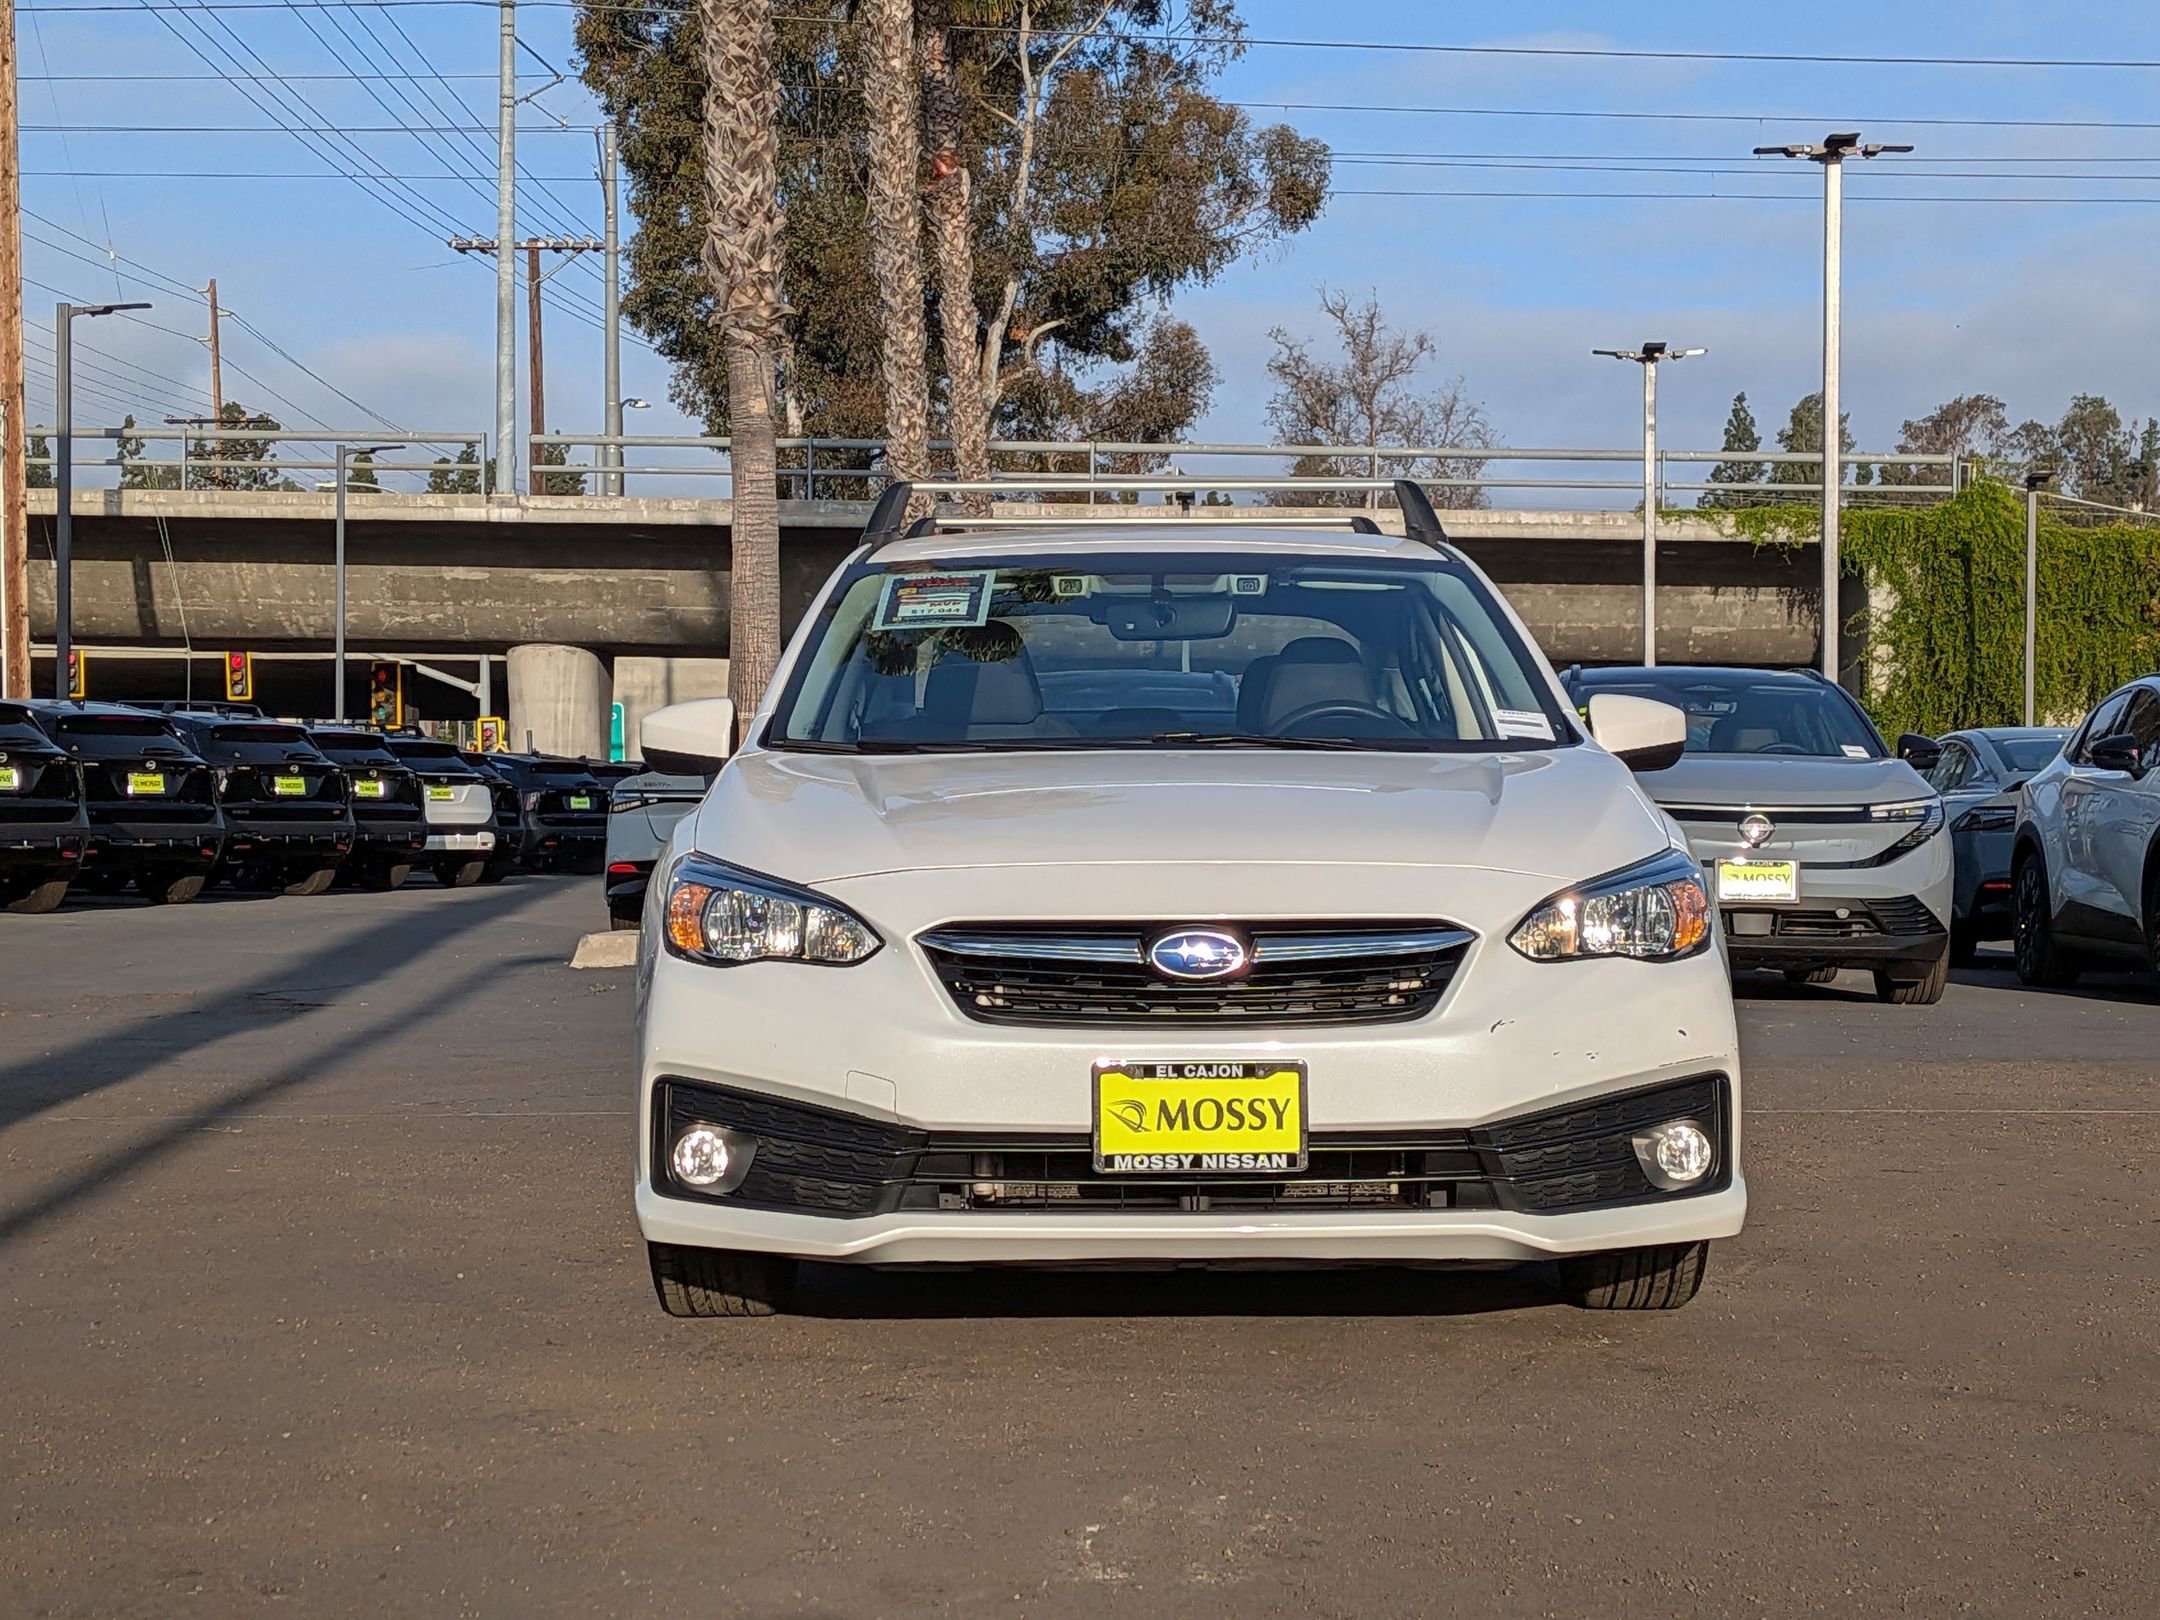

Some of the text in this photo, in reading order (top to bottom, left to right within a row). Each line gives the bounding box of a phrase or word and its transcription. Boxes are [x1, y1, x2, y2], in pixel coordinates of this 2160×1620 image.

[1156, 1064, 1243, 1077] EL CAJON
[1156, 1098, 1291, 1131] MOSSY
[1114, 1154, 1287, 1169] MOSSY NISSAN
